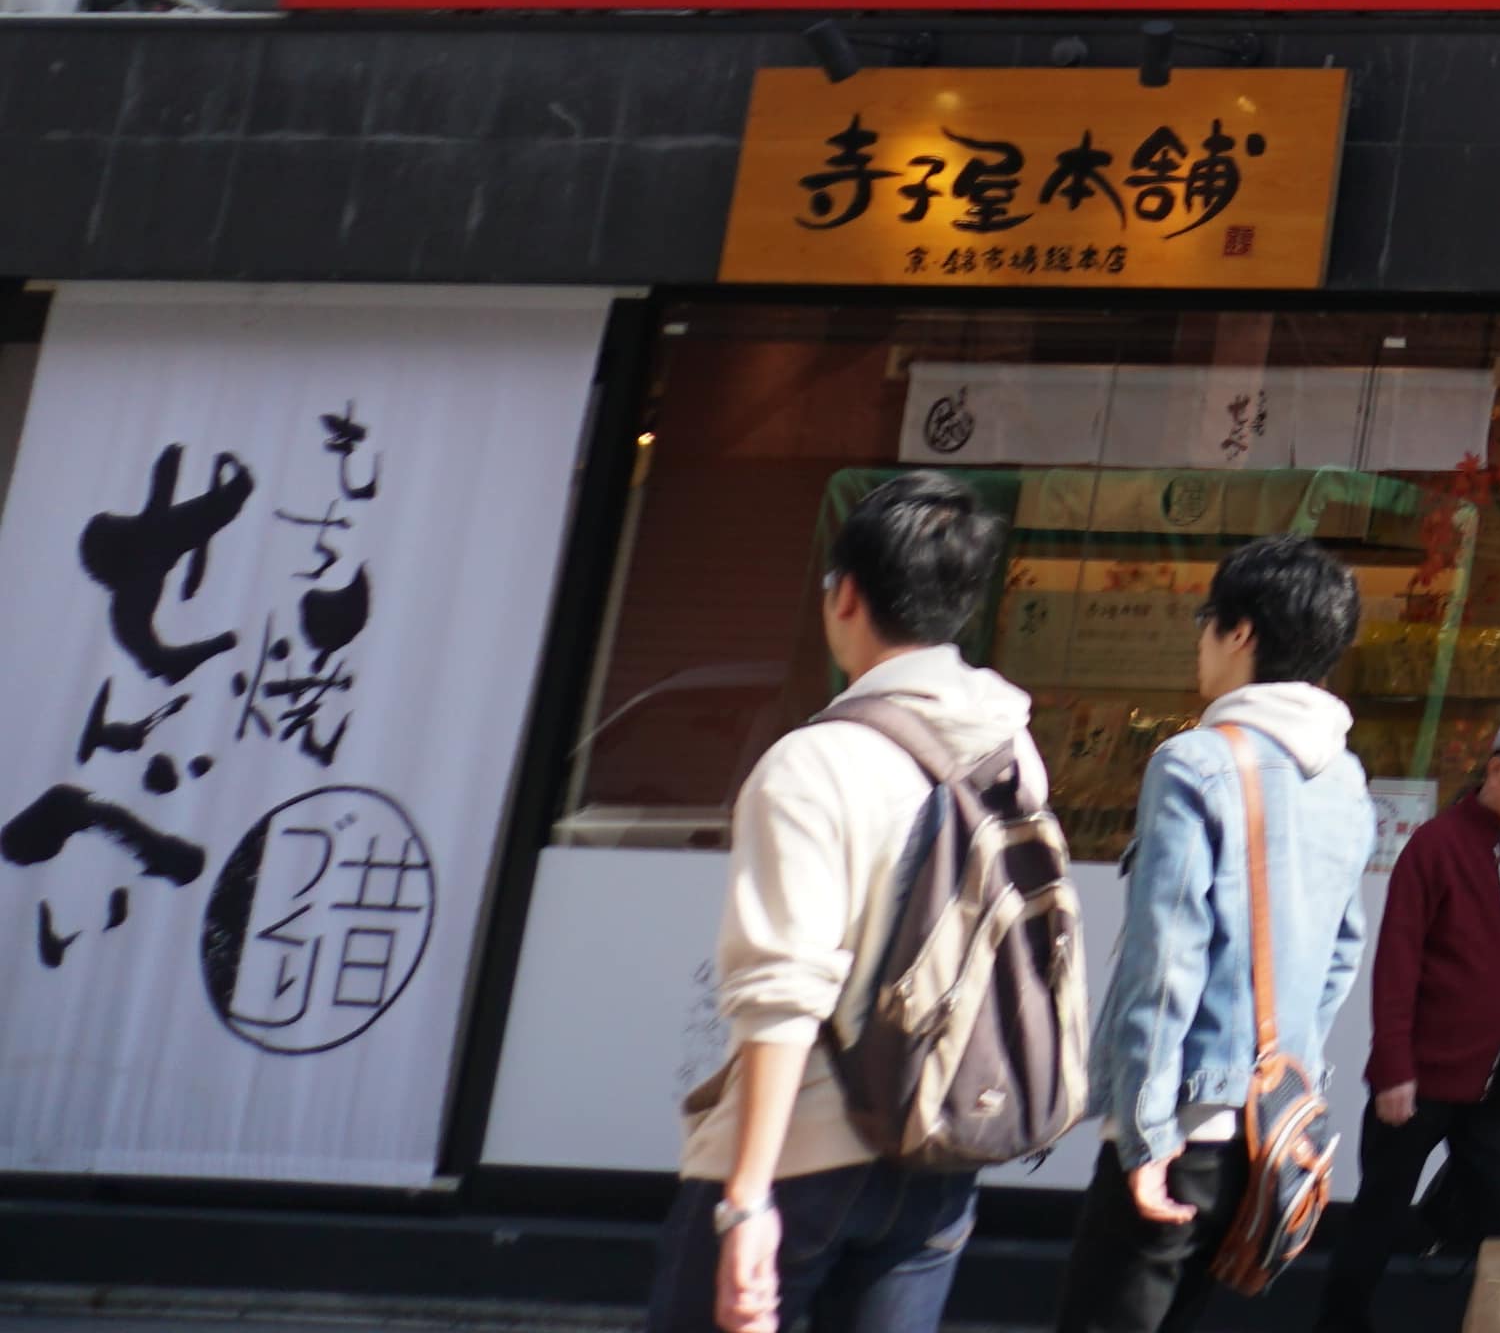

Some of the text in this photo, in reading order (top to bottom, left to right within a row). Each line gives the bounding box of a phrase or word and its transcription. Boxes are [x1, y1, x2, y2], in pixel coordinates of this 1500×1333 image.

[793, 112, 1267, 240] 寺子屋本舗
